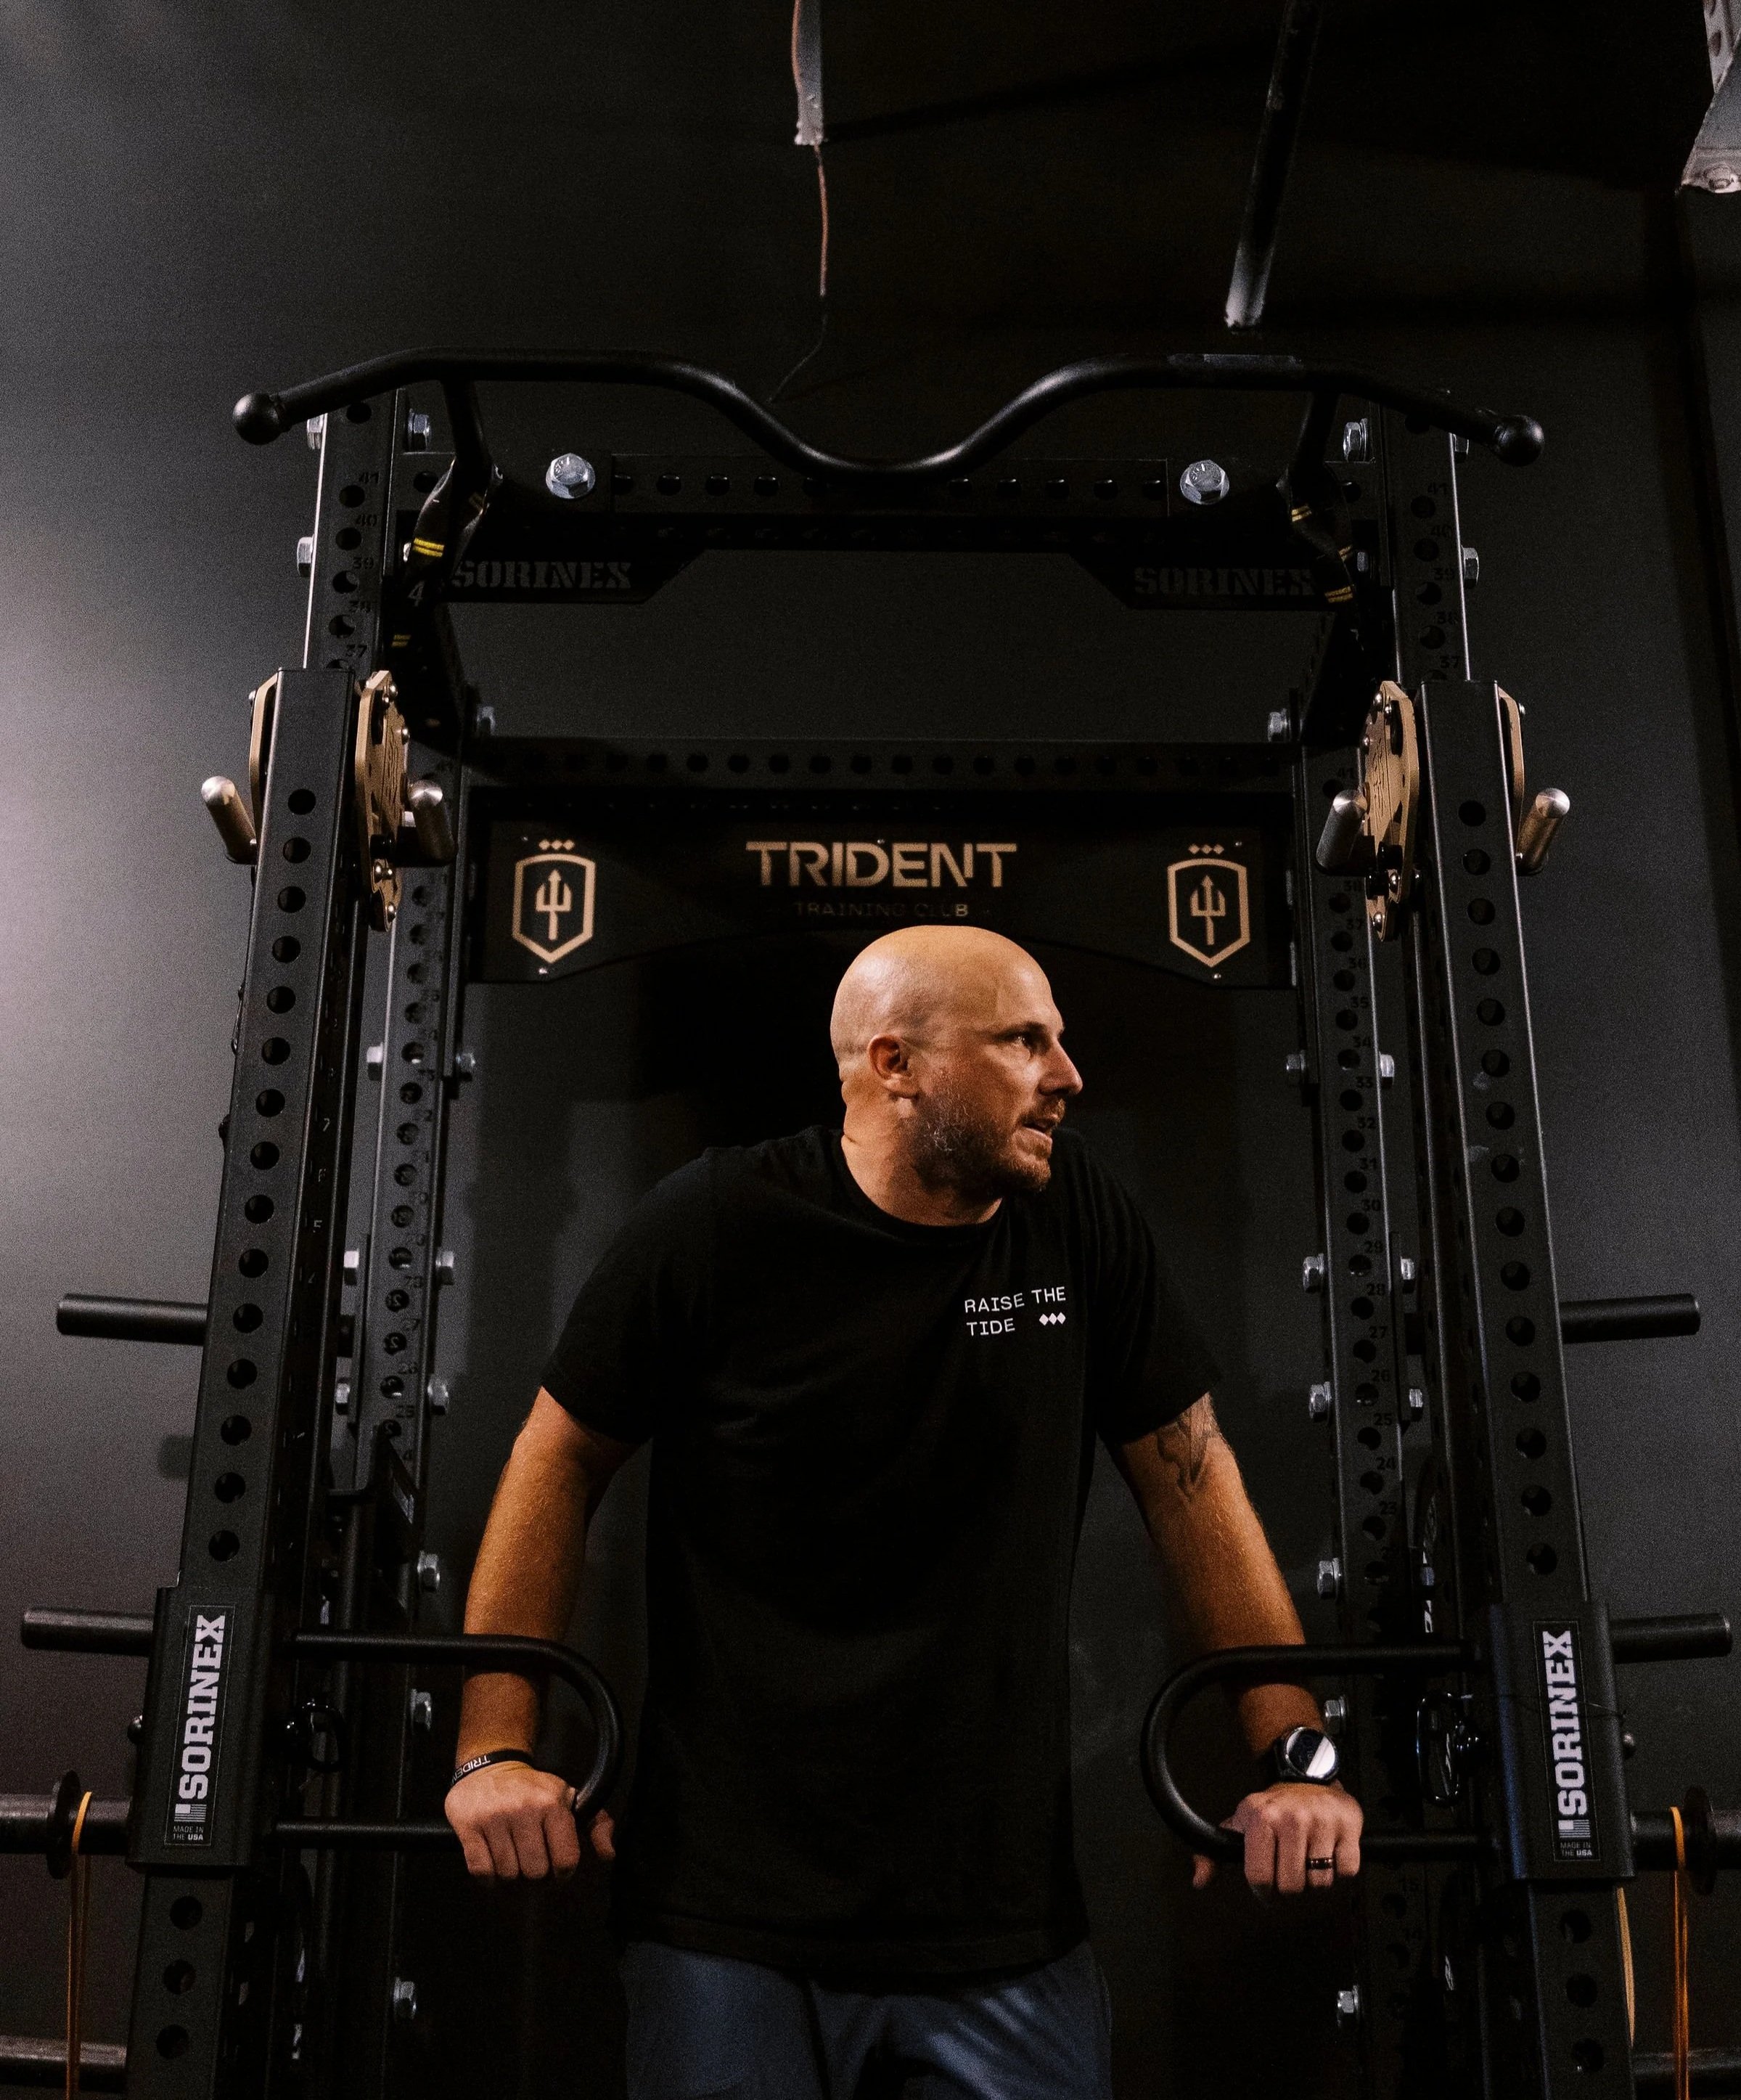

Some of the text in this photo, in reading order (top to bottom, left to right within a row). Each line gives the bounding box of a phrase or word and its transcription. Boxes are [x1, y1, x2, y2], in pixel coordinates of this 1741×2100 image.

[450, 560, 632, 589] SORINEX
[1133, 567, 1316, 597] SORINEX
[745, 841, 1017, 888] TRIDENT
[794, 902, 970, 918] TRAINING CLUB
[964, 1286, 1066, 1313] RAISE THE
[966, 1317, 1016, 1336] TIDE
[178, 1614, 226, 1799] SORINEX
[1542, 1630, 1588, 1815] SORINEX
[451, 1754, 491, 1784] TRIDEN
